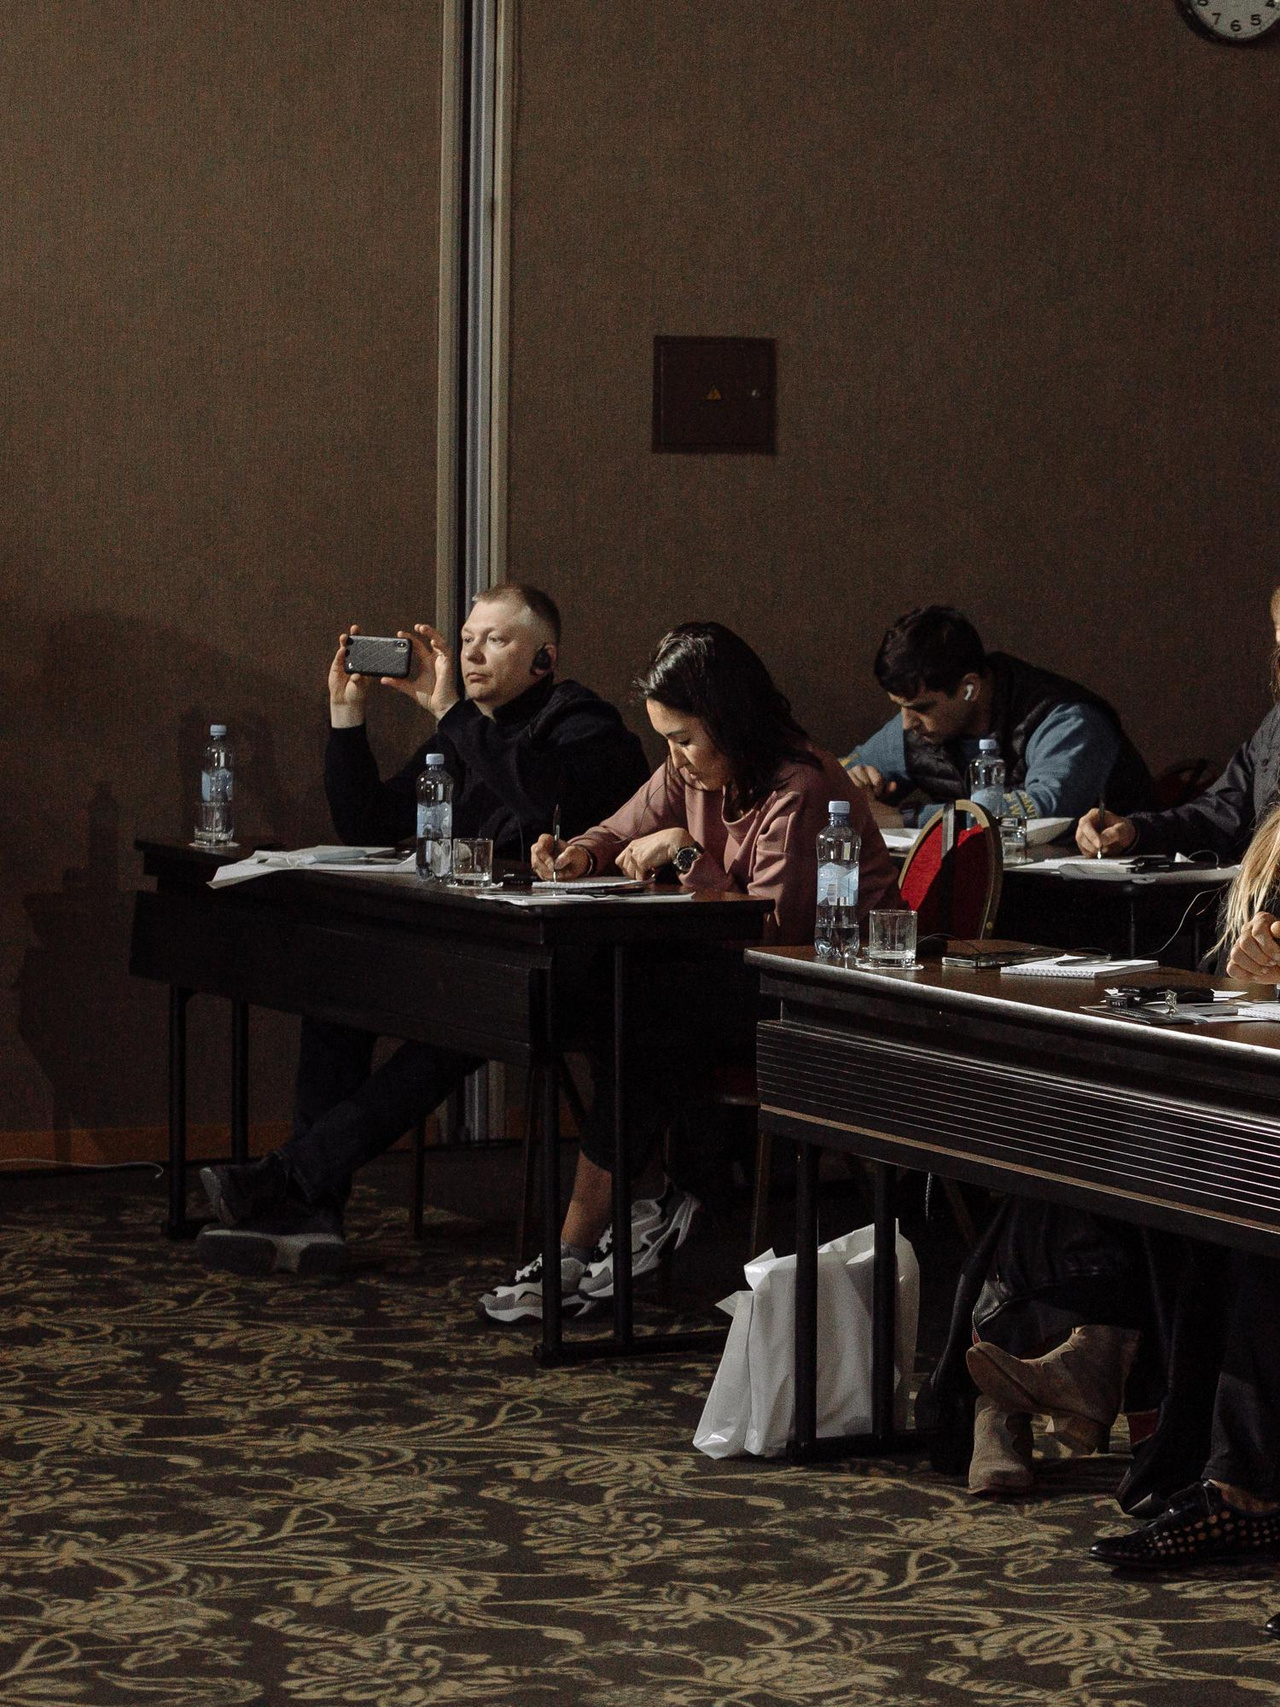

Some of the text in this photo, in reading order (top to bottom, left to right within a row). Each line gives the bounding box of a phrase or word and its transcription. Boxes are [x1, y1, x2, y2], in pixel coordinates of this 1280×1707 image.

[1212, 13, 1221, 25] 7
[1250, 14, 1261, 26] 5
[1230, 20, 1241, 32] 6
